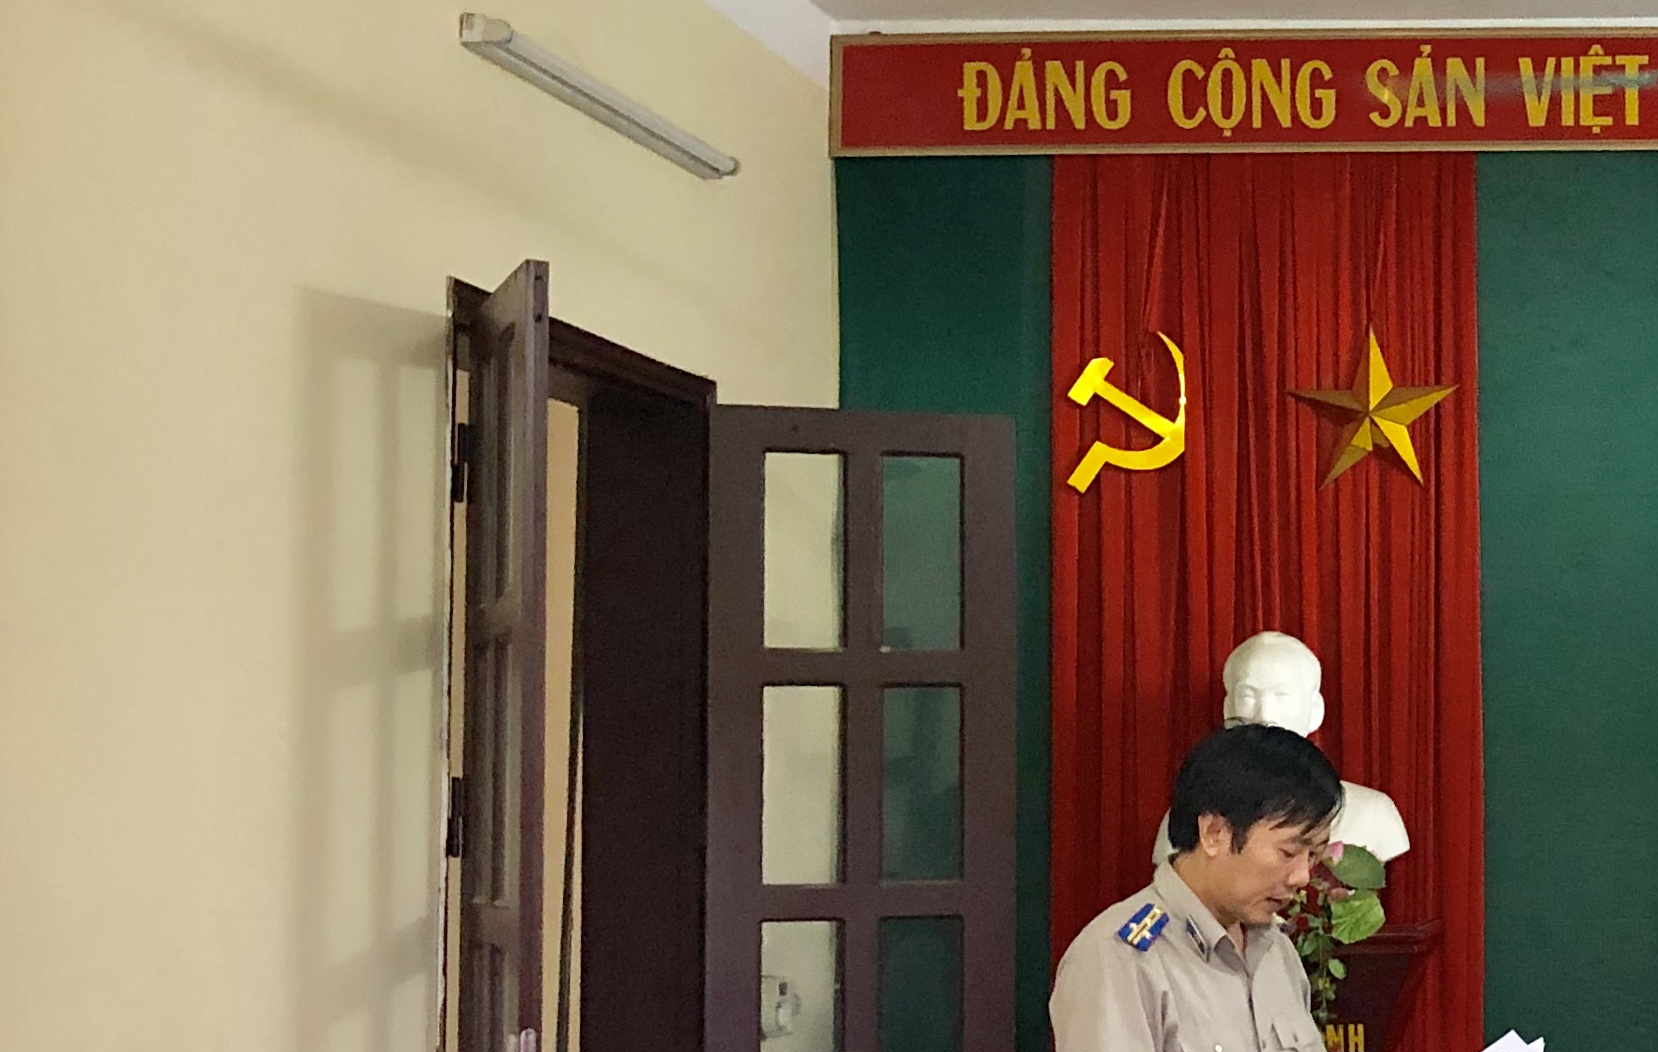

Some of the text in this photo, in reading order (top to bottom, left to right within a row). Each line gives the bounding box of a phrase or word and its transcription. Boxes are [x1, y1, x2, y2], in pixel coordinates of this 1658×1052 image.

[957, 48, 1132, 131] ĐẢNG
[1167, 47, 1337, 137] CỘNG
[1366, 44, 1486, 128] SẢN
[1517, 45, 1649, 134] VIỆT
